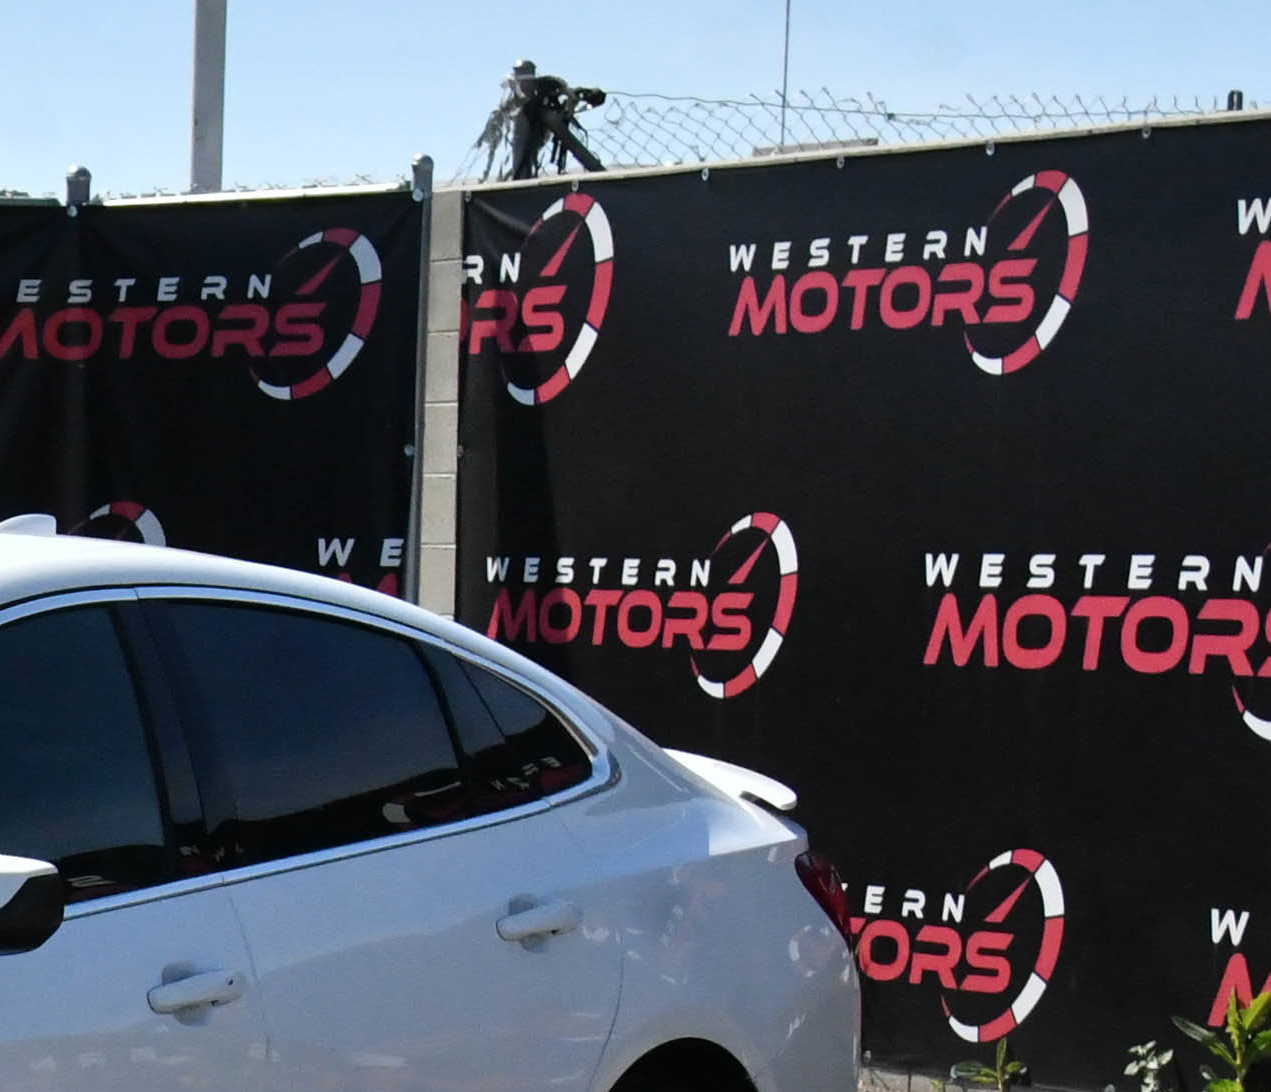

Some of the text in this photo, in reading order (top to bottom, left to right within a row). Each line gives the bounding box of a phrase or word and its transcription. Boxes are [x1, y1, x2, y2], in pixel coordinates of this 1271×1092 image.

[729, 225, 988, 273] WESTERN
[728, 257, 1039, 337] MOTORS
[486, 556, 711, 588] WESTERN
[925, 552, 1264, 592] WESTERN
[486, 586, 755, 651] MOTORS
[923, 592, 1271, 678] MOTOR
